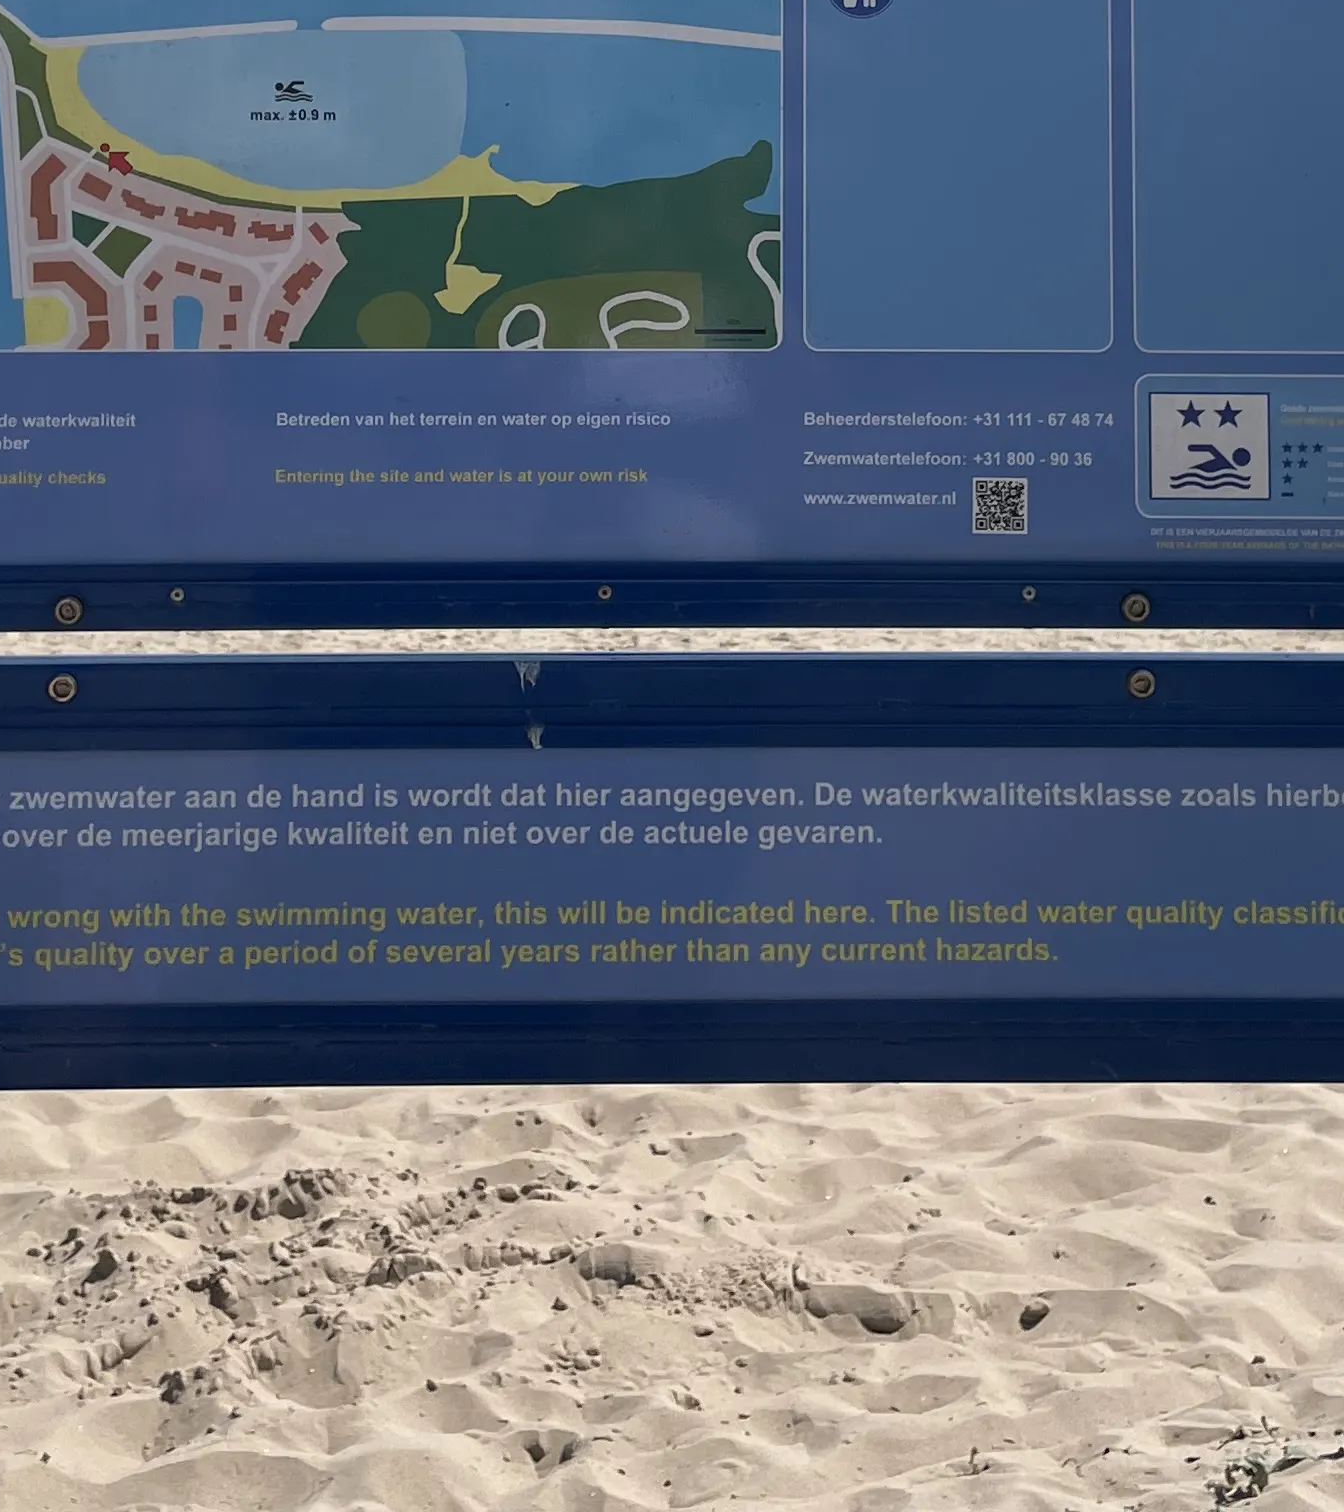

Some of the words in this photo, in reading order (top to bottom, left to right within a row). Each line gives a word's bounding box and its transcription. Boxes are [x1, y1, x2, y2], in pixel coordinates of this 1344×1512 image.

[250, 111, 285, 121] max.
[288, 108, 320, 121] ±0.9
[323, 111, 337, 121] m
[22, 412, 136, 428] waterkwaliteit
[276, 411, 350, 427] Betreden
[354, 415, 384, 427] van
[389, 411, 416, 426] het
[419, 411, 473, 427] terrein
[477, 414, 497, 426] en
[501, 412, 548, 426] water
[550, 414, 573, 429] op
[576, 411, 621, 429] eigen
[625, 411, 671, 426] risico
[803, 411, 968, 426] Beheerderstelefoon:
[973, 412, 1000, 427] +31
[1007, 412, 1032, 427] 111
[1047, 412, 1067, 427] 67
[1070, 412, 1091, 427] 48
[1094, 412, 1114, 427] 74
[803, 451, 967, 466] Zwemwatertelefoon:
[972, 451, 1001, 466] +31
[1006, 451, 1035, 466] 800
[1049, 451, 1069, 467] 90
[1073, 451, 1093, 467] 36
[47, 470, 107, 485] checks
[275, 468, 345, 487] Entering
[349, 468, 376, 483] the
[379, 469, 409, 483] site
[414, 469, 444, 484] and
[449, 468, 495, 482] water
[498, 468, 513, 482] is
[517, 469, 533, 482] at
[537, 471, 576, 486] your
[578, 471, 613, 483] own
[618, 467, 648, 483] risk
[803, 490, 957, 505] www.zwemwater.nl
[9, 785, 177, 810] zwemwater
[184, 789, 237, 809] aan
[246, 783, 282, 809] de
[292, 783, 364, 808] hand
[374, 783, 399, 808] is
[407, 783, 492, 808] wordt
[500, 783, 547, 808] dat
[556, 782, 613, 807] hier
[620, 787, 804, 813] aangegeven.
[815, 782, 853, 807] De
[861, 782, 1172, 807] waterkwaliteitsklasse
[1181, 782, 1257, 807] zoals
[2, 829, 69, 848] over
[76, 822, 112, 847] de
[122, 821, 278, 853] meerjarige
[287, 820, 409, 846] kwaliteit
[417, 826, 453, 845] en
[463, 820, 518, 845] niet
[525, 825, 591, 844] over
[599, 819, 635, 844] de
[643, 819, 749, 845] actuele
[758, 824, 883, 850] gevaren.
[7, 908, 100, 935] wrong
[109, 903, 171, 928] with
[180, 902, 227, 927] the
[236, 901, 386, 932] swimming
[396, 902, 484, 929] water,
[494, 900, 547, 926] this
[557, 899, 606, 924] will
[616, 899, 651, 925] be
[661, 899, 794, 925] indicated
[804, 899, 875, 924] here.
[885, 899, 939, 925] The
[949, 899, 1028, 924] listed
[1036, 900, 1118, 924] water
[1126, 899, 1224, 931] quality
[34, 940, 135, 972] quality
[143, 946, 210, 965] over
[218, 946, 234, 965] a
[244, 938, 338, 970] period
[347, 938, 379, 964] of
[385, 939, 491, 964] several
[500, 943, 581, 969] years
[591, 938, 678, 963] rather
[686, 937, 750, 963] than
[759, 942, 812, 968] any
[821, 938, 927, 962] current
[936, 936, 1058, 962] hazards.
